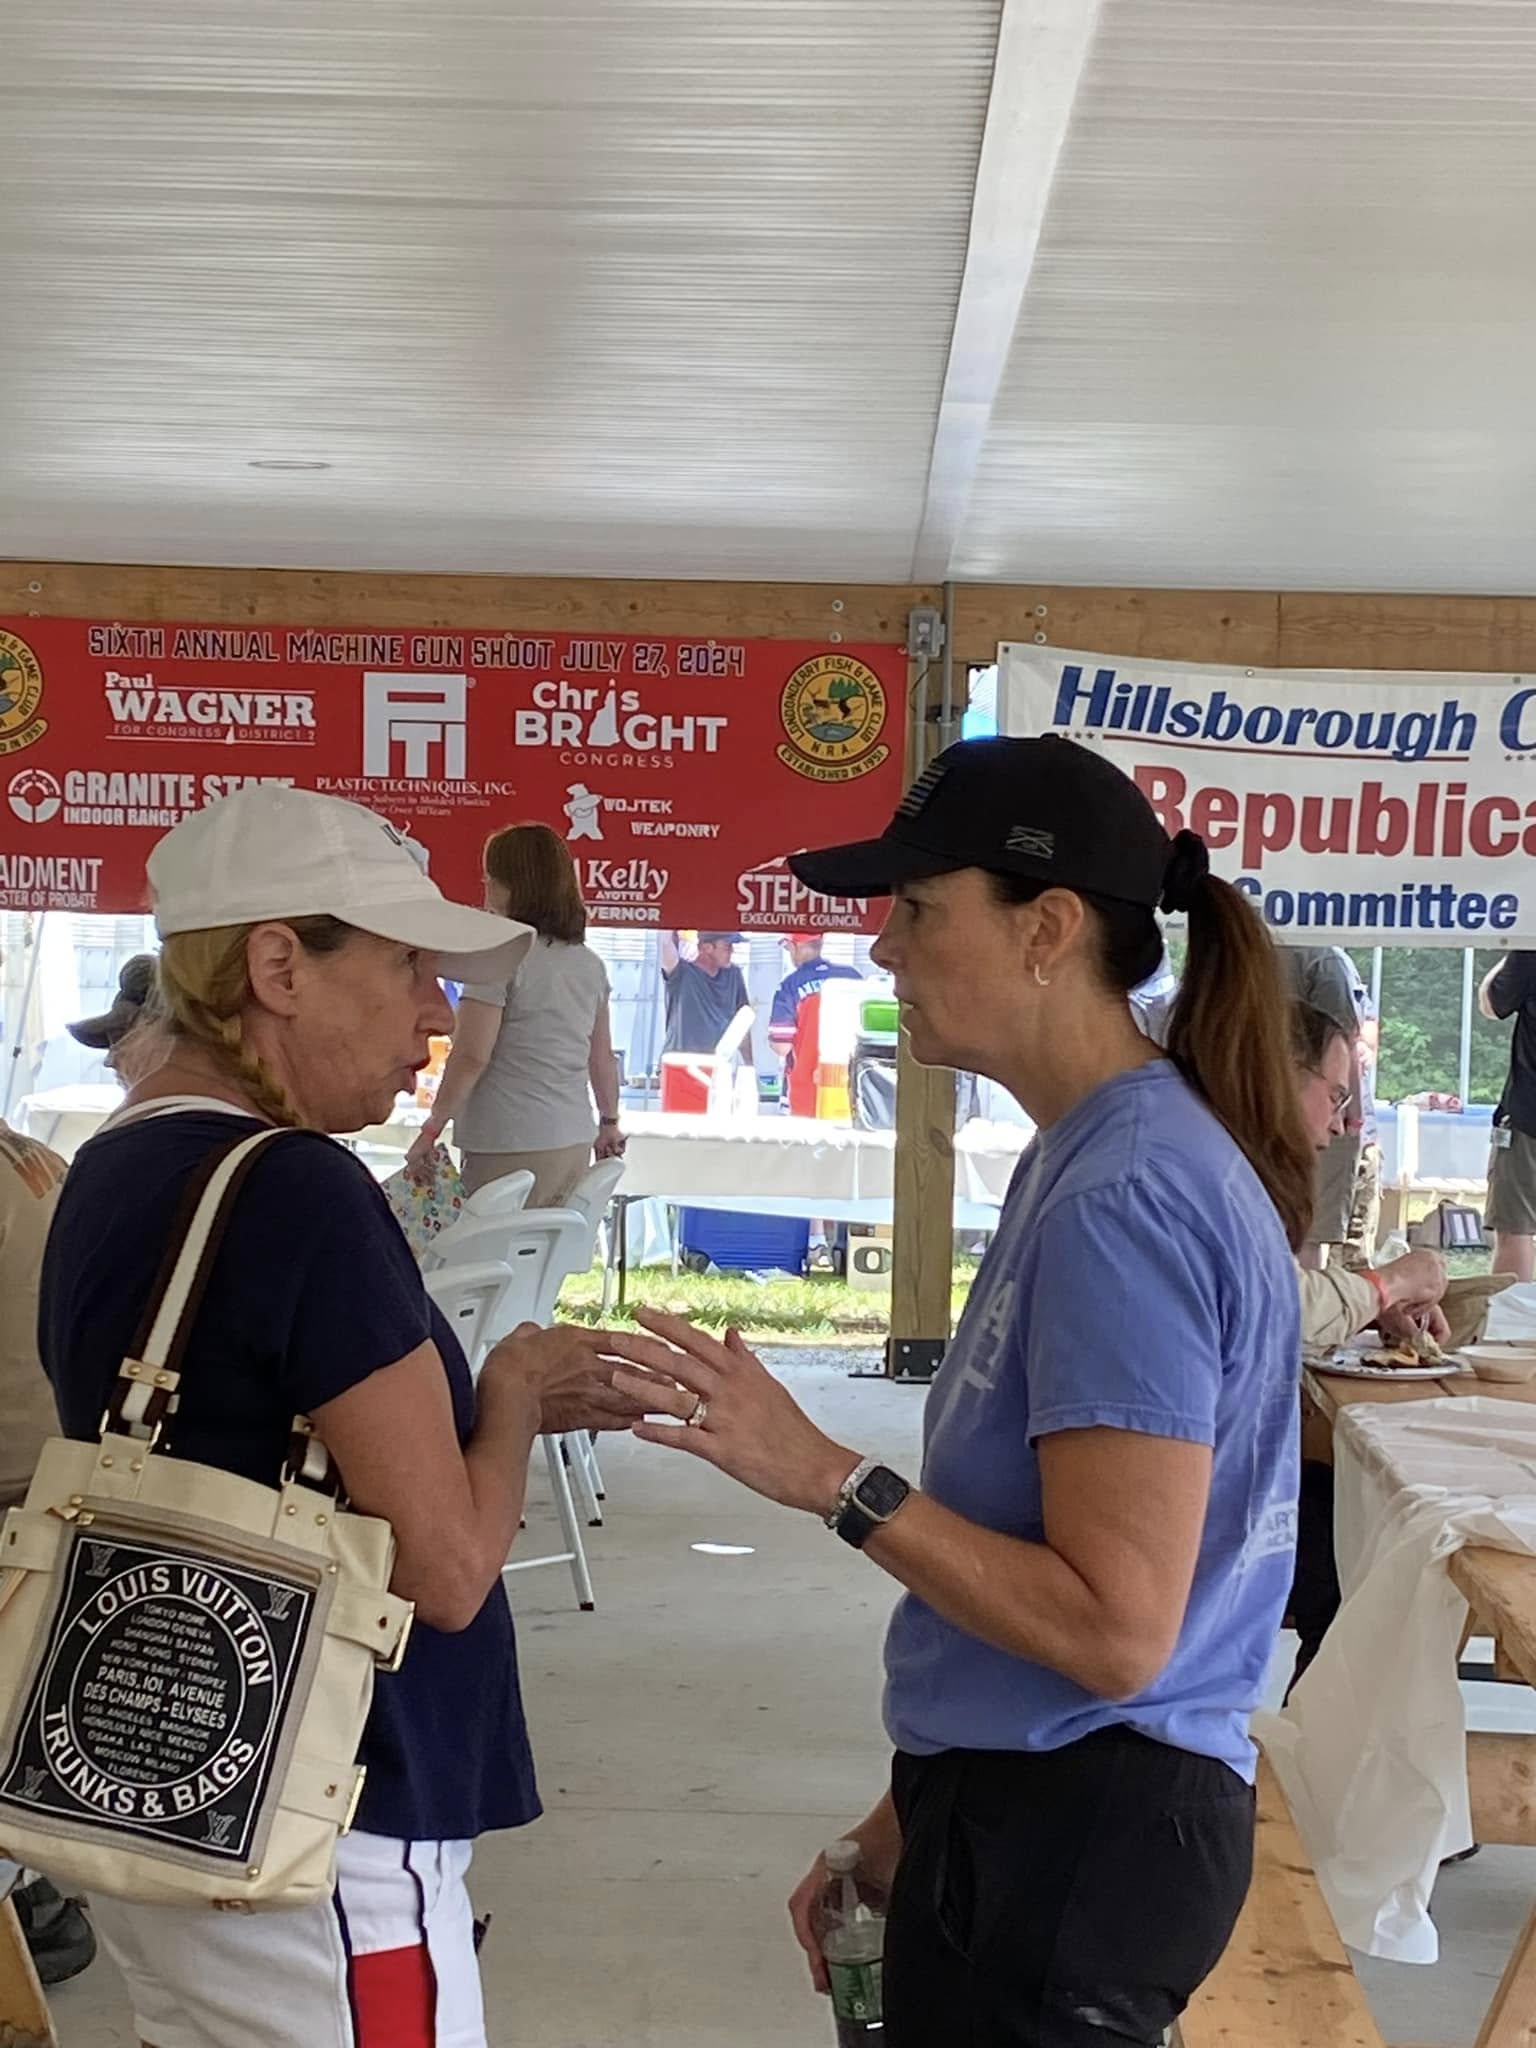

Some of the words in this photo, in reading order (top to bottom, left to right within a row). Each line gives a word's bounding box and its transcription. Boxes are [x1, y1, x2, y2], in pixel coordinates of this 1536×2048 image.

[18, 649, 39, 681] GAME
[88, 626, 164, 658] SIXTH
[172, 629, 279, 661] ANNUAL
[287, 632, 404, 665] MACHINE
[411, 636, 463, 666] GUN
[471, 638, 555, 670] SHOOT
[561, 640, 624, 671] JULY
[633, 643, 669, 678] 27,
[678, 645, 745, 677] 2024
[824, 657, 854, 671] FISH
[104, 671, 154, 690] Paul
[532, 679, 640, 713] Chris
[863, 675, 882, 708] GAME
[18, 686, 39, 716] CLUB
[104, 689, 317, 728] WAGNER
[783, 660, 820, 741] LONDONDERRY
[1052, 664, 1477, 762] Hillsborough
[114, 724, 141, 736] FOR
[146, 725, 222, 738] CONGRESS
[239, 728, 302, 742] DISTRICT
[307, 730, 316, 741] 2
[860, 712, 882, 743] CLUB
[559, 750, 675, 769] CONGRESS
[780, 748, 849, 779] ESTABLISHED
[851, 766, 863, 774] IN
[64, 770, 196, 808] GRANITE
[316, 776, 380, 792] PLASTIC
[484, 781, 517, 797] INC.
[63, 807, 125, 826] INDOOR
[128, 809, 179, 828] RANGE
[601, 797, 673, 815] WOJTEK
[1134, 765, 1536, 870] Republic
[630, 821, 721, 839] WEAPONRY
[585, 859, 669, 900] Kelly
[30, 890, 47, 907] OF
[48, 891, 98, 909] PROBATE
[595, 890, 645, 901] AYOTTE
[584, 906, 661, 921] VERNOR
[740, 912, 808, 927] EXECUTIVE
[809, 914, 863, 928] COUNCIL
[78, 1566, 171, 1635] LOUIS
[180, 1567, 273, 1686] VUITTON
[130, 1614, 171, 1631] LONDON
[170, 1621, 212, 1640] GENEVA
[144, 1603, 177, 1619] TOKYO
[177, 1611, 207, 1627] ROME
[110, 1639, 138, 1652] HONG
[142, 1646, 173, 1660] KONG
[179, 1653, 219, 1671] SYDNEY
[175, 1638, 215, 1656] SAIPAN
[101, 1652, 122, 1665] NEW
[123, 1657, 150, 1671] YORK
[150, 1662, 181, 1678] SAINT
[187, 1671, 228, 1690] TROPEZ
[83, 1682, 108, 1701] DES
[108, 1687, 161, 1714] CHAMPS
[170, 1701, 227, 1730] ELYSEES
[168, 1682, 226, 1708] AVENUE
[81, 1716, 136, 1735] HONOLULU
[139, 1728, 163, 1741] NICE
[167, 1734, 208, 1752] MEXICO
[84, 1702, 104, 1715] LOS
[107, 1708, 153, 1726] ANGELES
[160, 1720, 210, 1739] BANGKOK
[45, 1703, 135, 1815] TRUNKS
[142, 1790, 166, 1818] &
[171, 1738, 254, 1812] BAGS
[87, 1730, 124, 1746] OSAKA
[130, 1740, 152, 1753] LAS
[158, 1746, 196, 1763] VEGAS
[94, 1746, 141, 1764] MOSCOW
[144, 1757, 181, 1774] MILANO
[107, 1762, 159, 1782] FLORENCE
